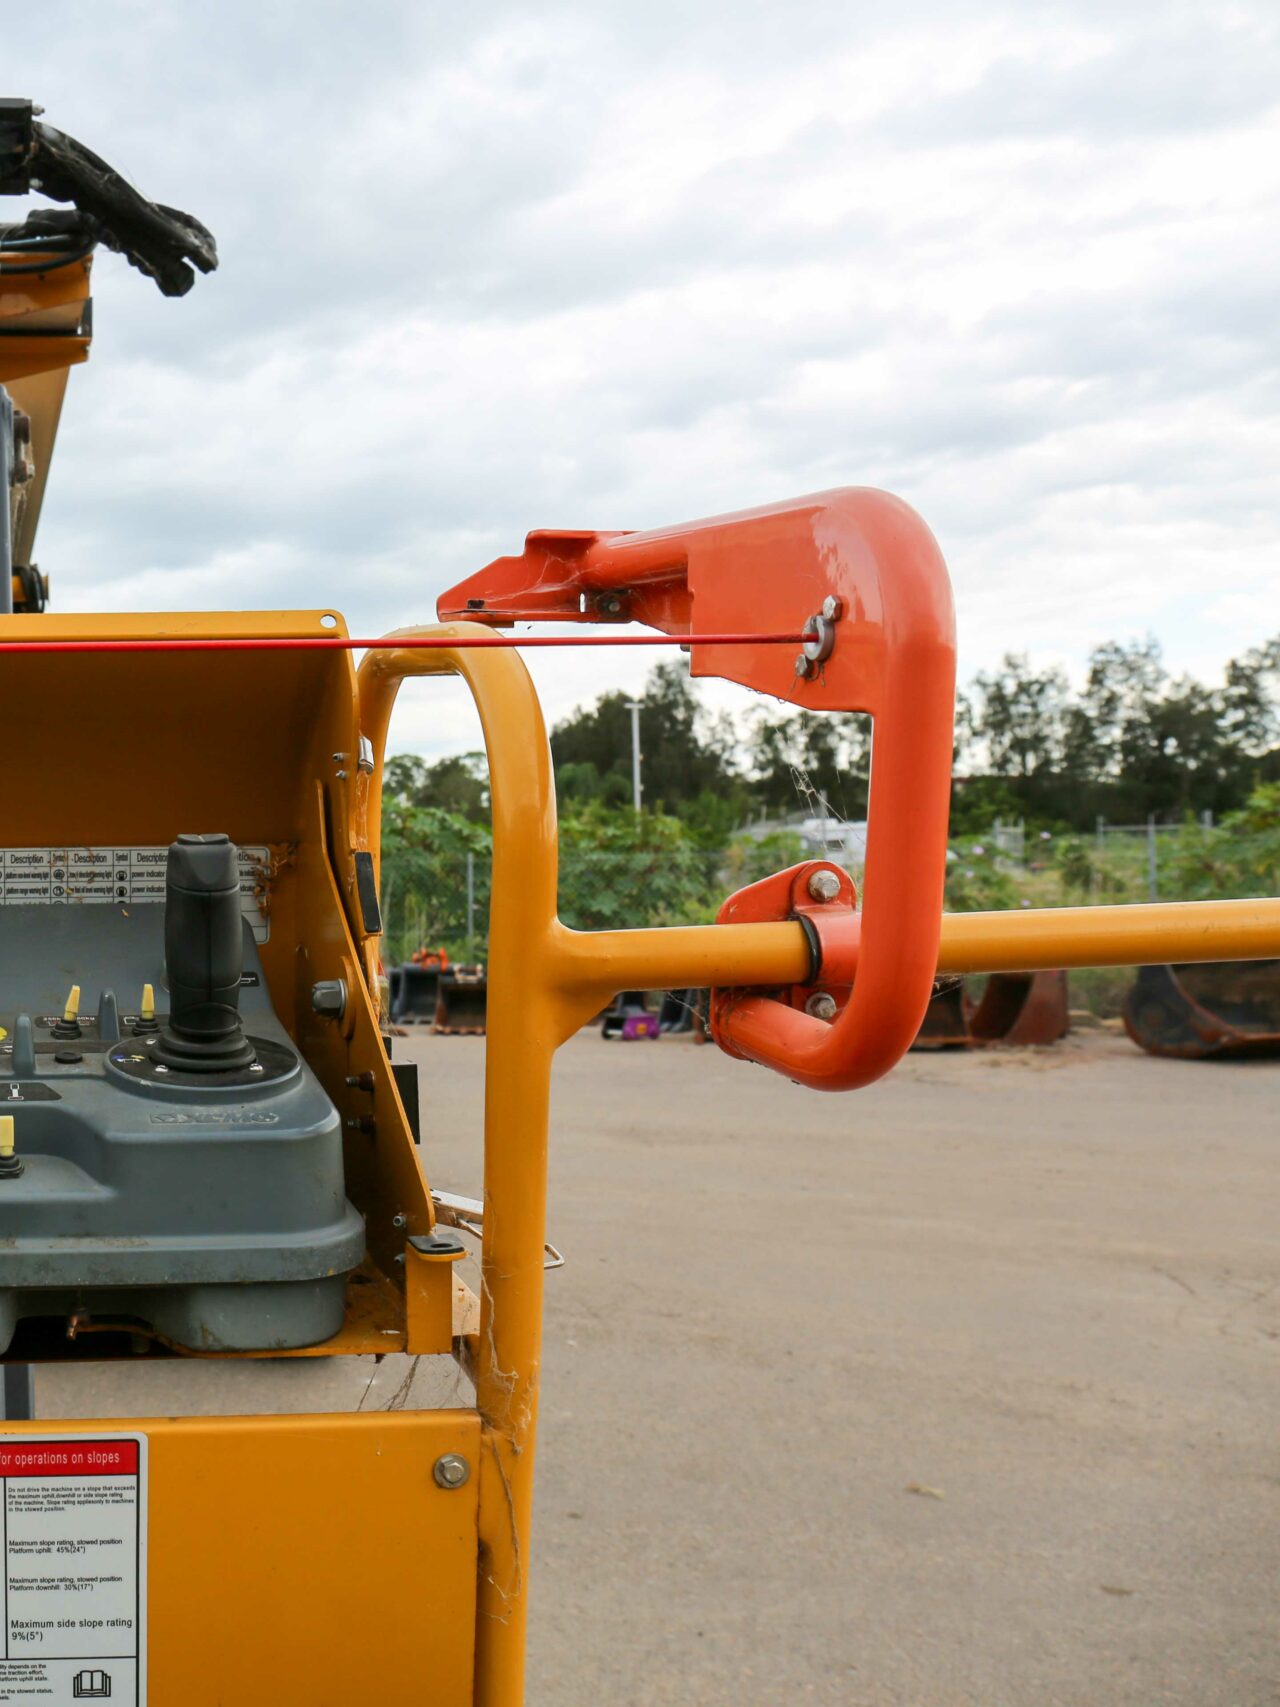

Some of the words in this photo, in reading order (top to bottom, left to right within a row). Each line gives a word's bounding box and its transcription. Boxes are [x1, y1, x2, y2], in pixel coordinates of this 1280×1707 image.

[11, 854, 43, 864] Description
[15, 1452, 68, 1467] operations
[72, 1453, 83, 1463] on
[87, 1451, 119, 1465] slopes
[11, 1620, 54, 1628] Maximum
[57, 1619, 76, 1627] side
[79, 1619, 103, 1628] slope
[107, 1618, 132, 1628] rating
[12, 1632, 43, 1642] 9%(5°)
